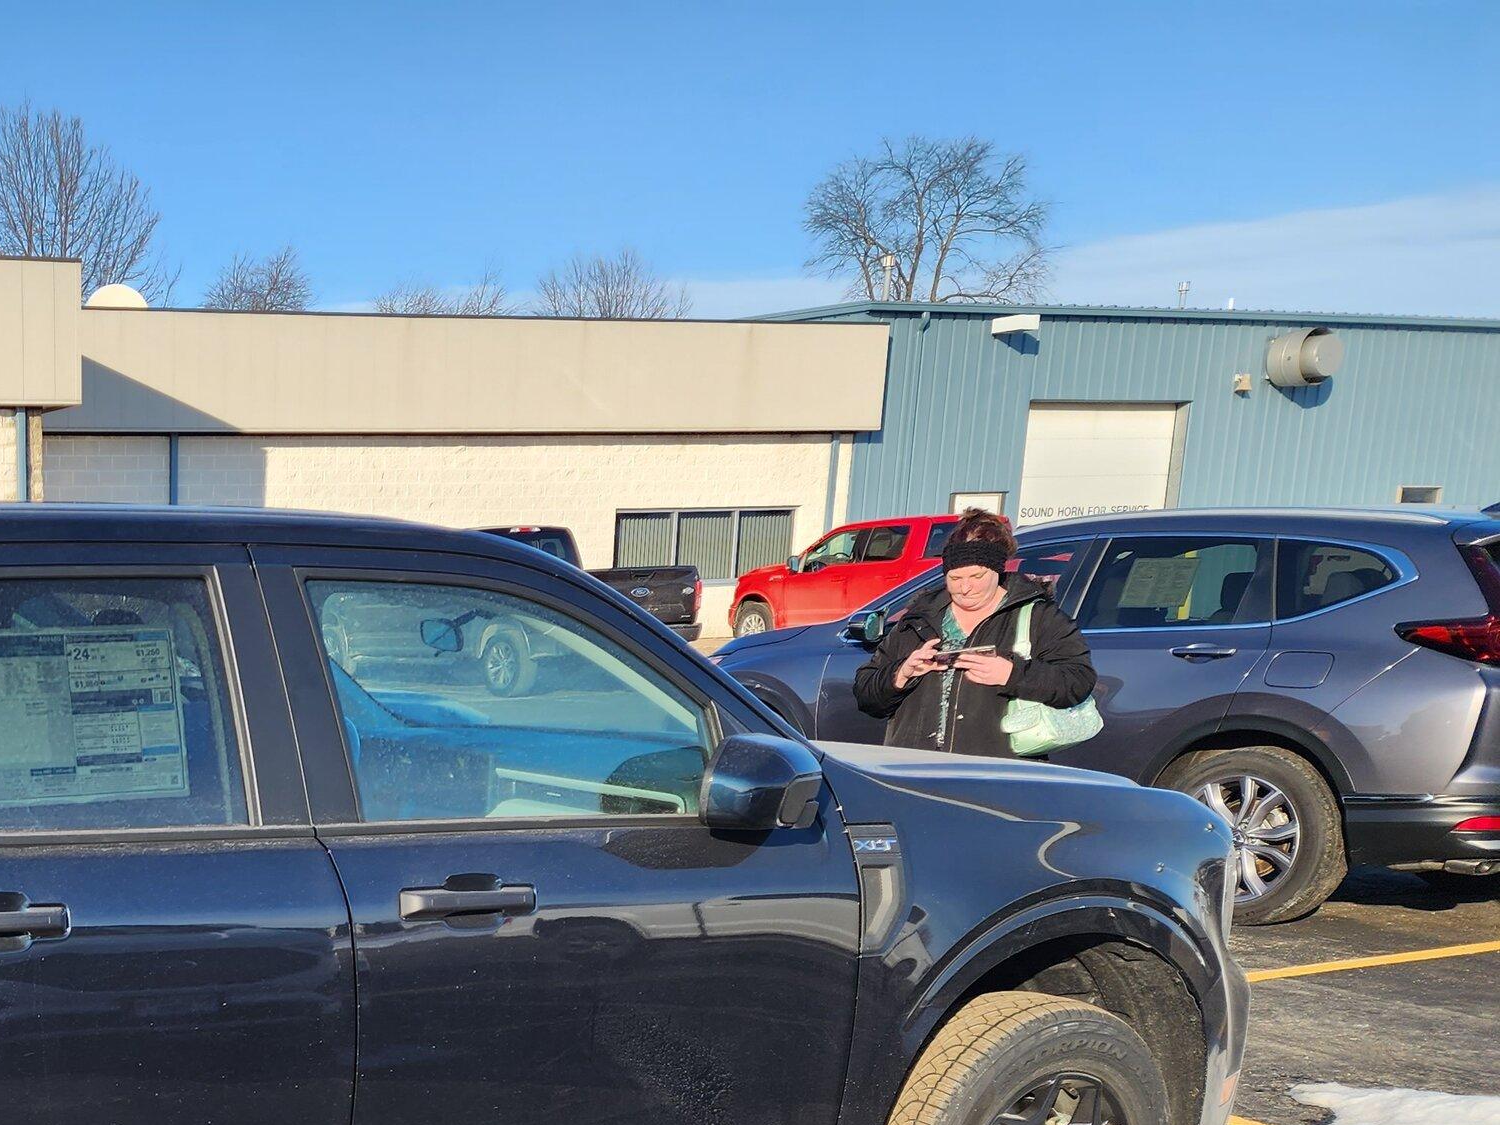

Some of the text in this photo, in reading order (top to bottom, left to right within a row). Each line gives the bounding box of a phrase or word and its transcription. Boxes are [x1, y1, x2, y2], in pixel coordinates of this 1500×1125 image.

[1020, 507, 1054, 518] SOUND
[1057, 506, 1084, 517] HORN
[1088, 506, 1106, 516] FOR
[73, 647, 90, 661] 24
[853, 839, 897, 851] XLT
